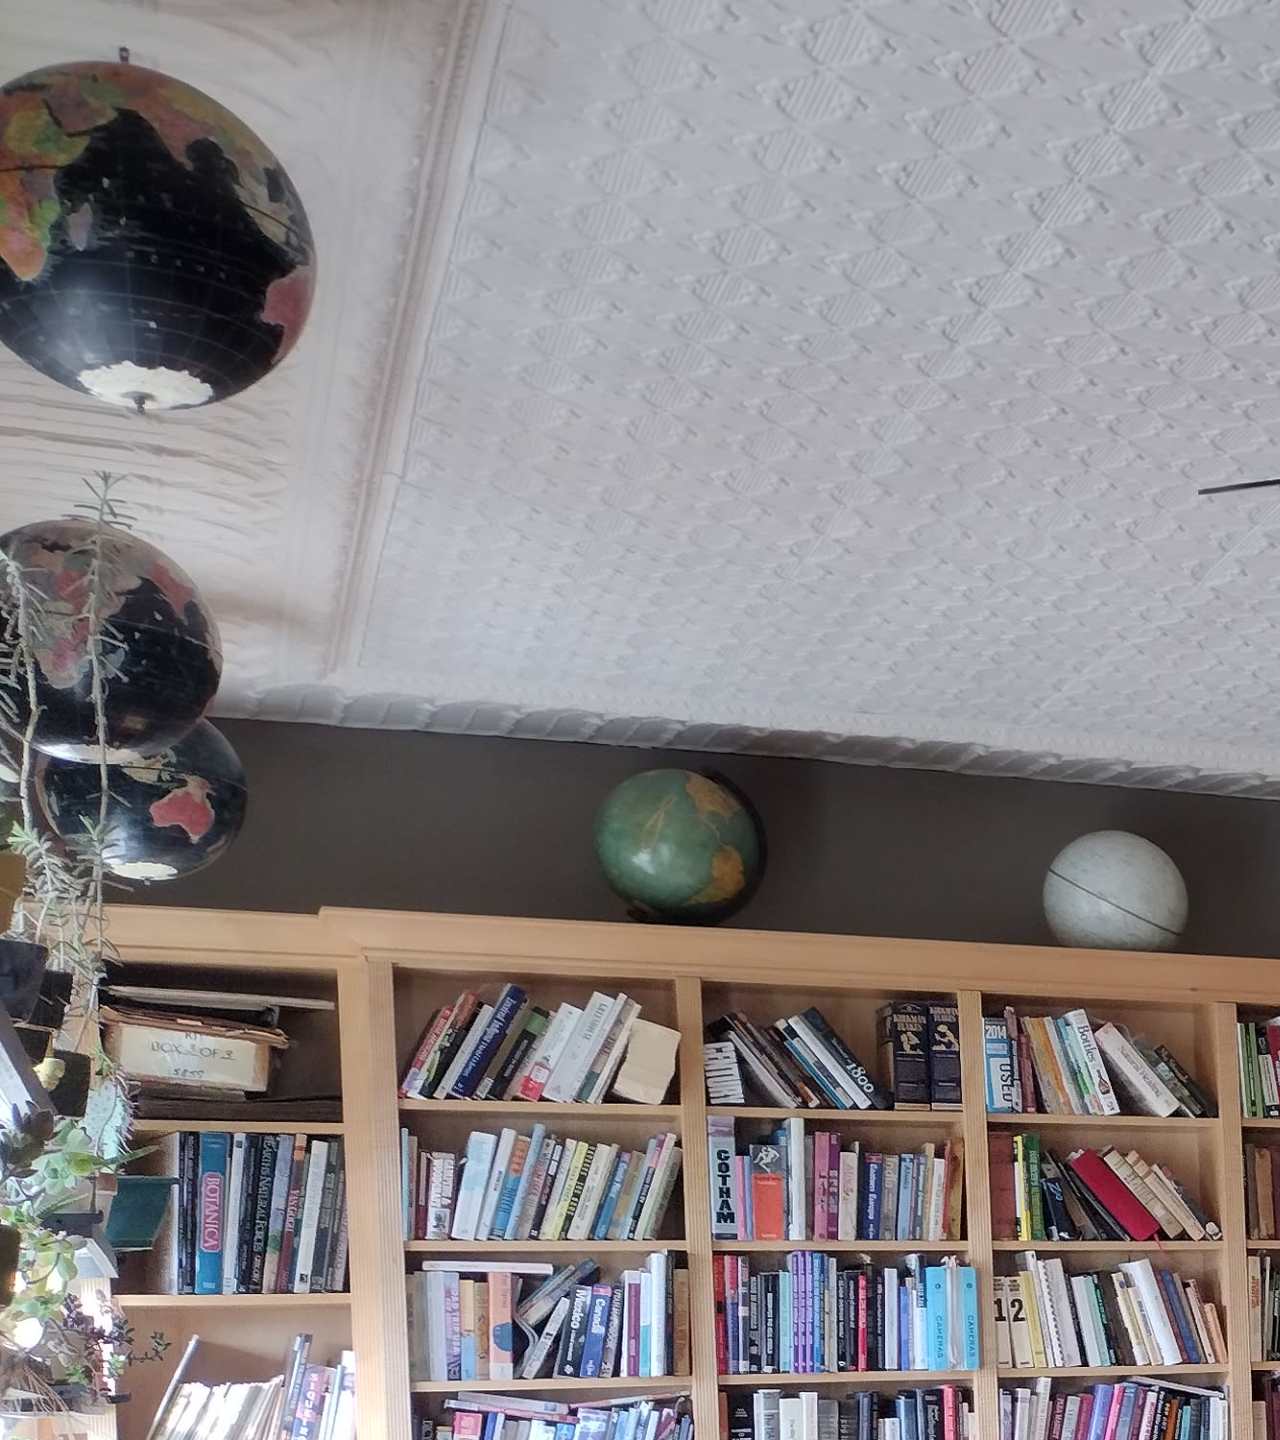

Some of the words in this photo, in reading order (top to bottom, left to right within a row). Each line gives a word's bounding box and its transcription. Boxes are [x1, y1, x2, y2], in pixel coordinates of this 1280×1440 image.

[151, 1040, 181, 1054] BOX
[199, 1047, 217, 1058] OF
[986, 1025, 1007, 1039] 2014
[1078, 1025, 1096, 1063] Bottles
[846, 1058, 876, 1094] 1800
[999, 1063, 1012, 1107] USED
[256, 1176, 273, 1219] NATURAL
[716, 1150, 736, 1225] GOTHAM
[866, 1193, 877, 1219] Europe
[203, 1178, 220, 1246] BOTANICA
[569, 1288, 587, 1329] Mexico
[590, 1298, 606, 1333] Canada
[994, 1298, 1006, 1321] 1
[1011, 1298, 1025, 1321] 2
[935, 1315, 943, 1358] CAMERAS
[966, 1314, 974, 1357] CAMERAS
